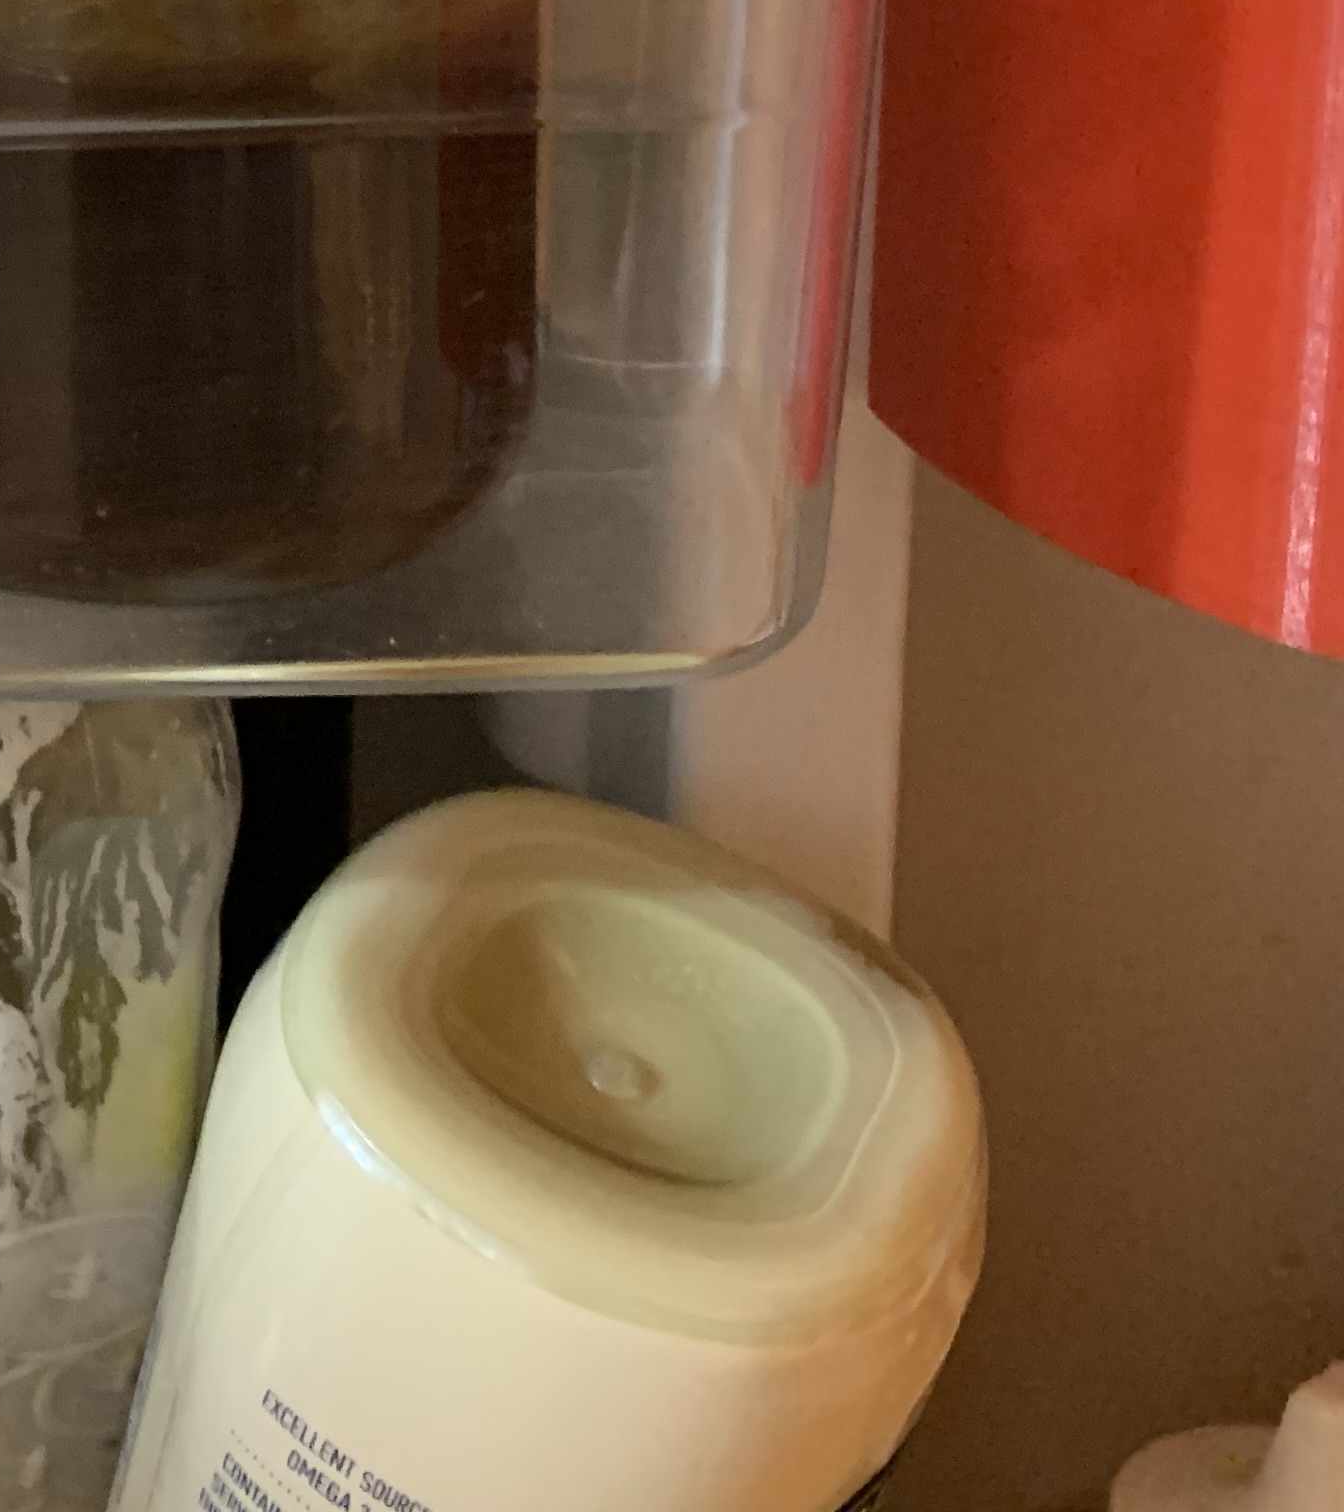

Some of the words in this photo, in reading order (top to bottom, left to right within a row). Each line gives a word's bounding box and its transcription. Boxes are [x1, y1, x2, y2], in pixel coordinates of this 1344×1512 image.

[262, 1388, 357, 1480] EXCELLENT
[359, 1470, 435, 1512] SOURC
[286, 1448, 352, 1512] OMEGA
